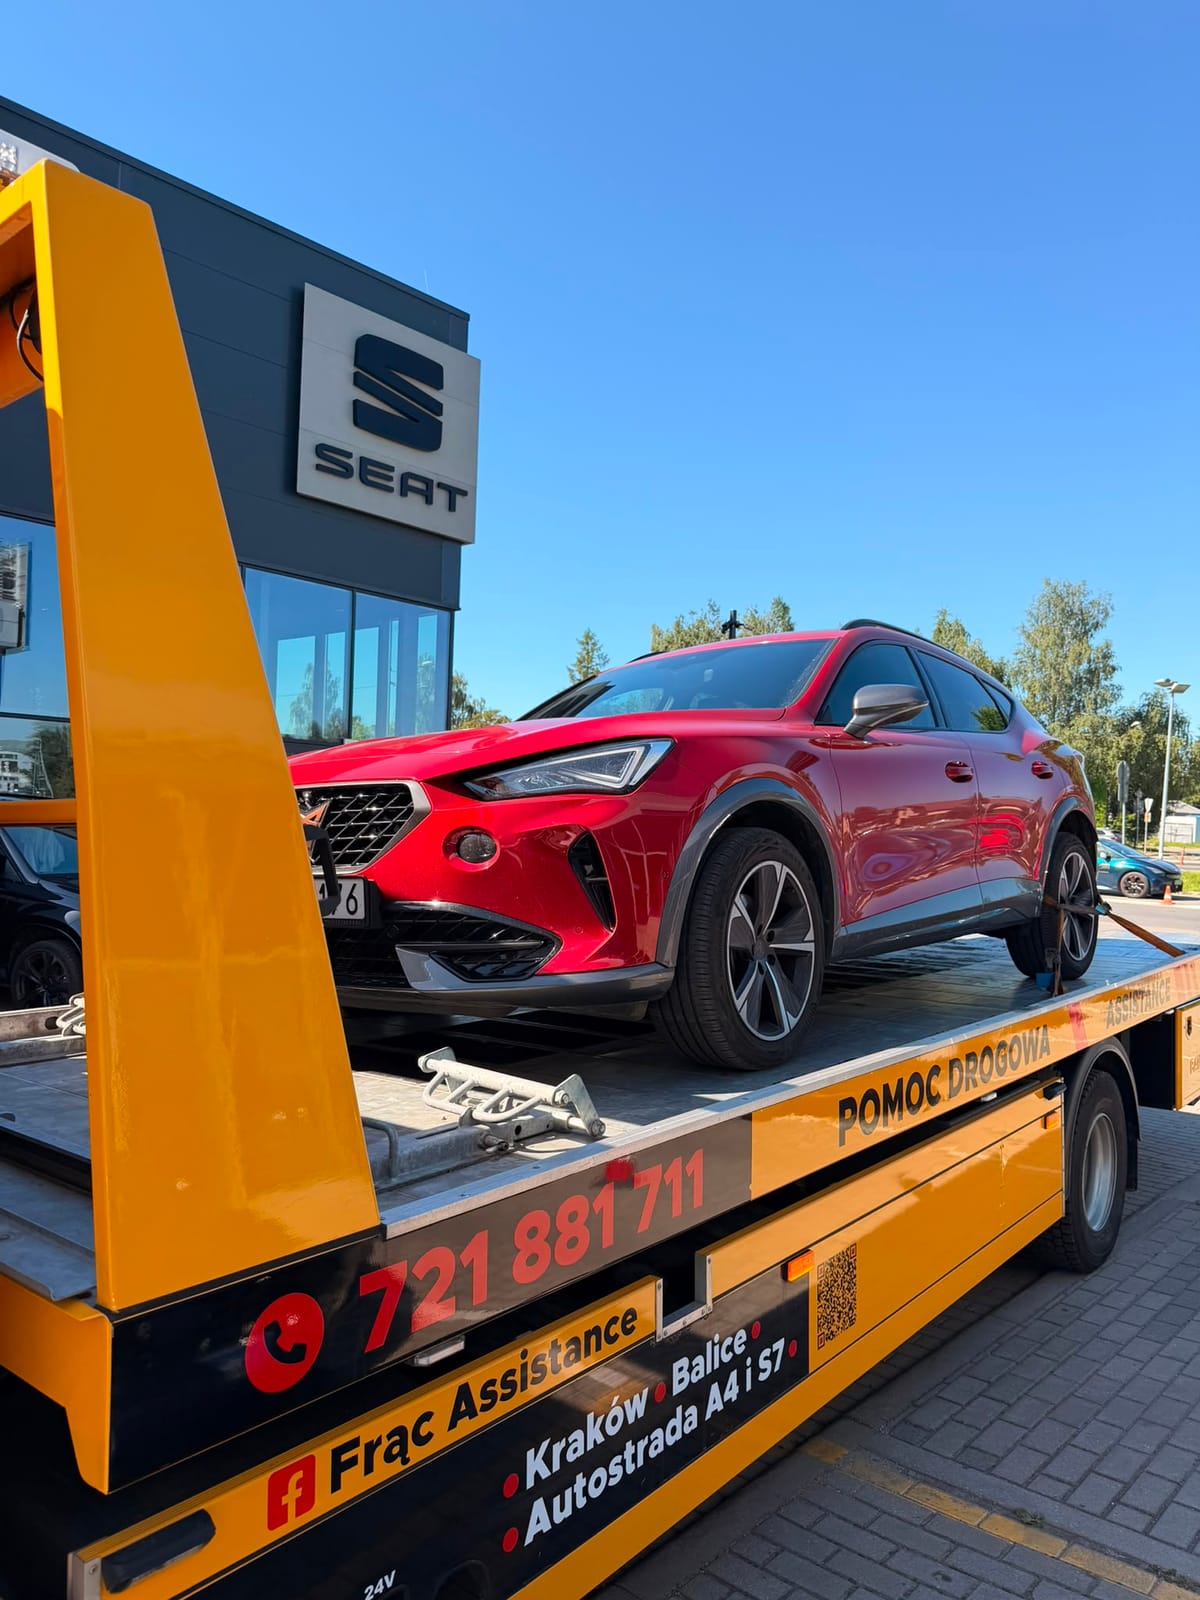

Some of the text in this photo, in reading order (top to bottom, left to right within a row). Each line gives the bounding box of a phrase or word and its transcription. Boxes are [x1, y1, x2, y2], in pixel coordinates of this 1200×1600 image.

[315, 443, 468, 513] SEAT
[1106, 977, 1171, 1029] ASSISTANCE
[838, 1024, 1051, 1147] POMOC DROGOWA
[359, 1149, 704, 1353] 721 881 711
[330, 1415, 434, 1495] Frąc
[447, 1307, 638, 1431] Assistance
[523, 1338, 785, 1547] Autostrada A4 i S7
[526, 1328, 747, 1490] Kraków Balice
[363, 1569, 397, 1600] 24V
